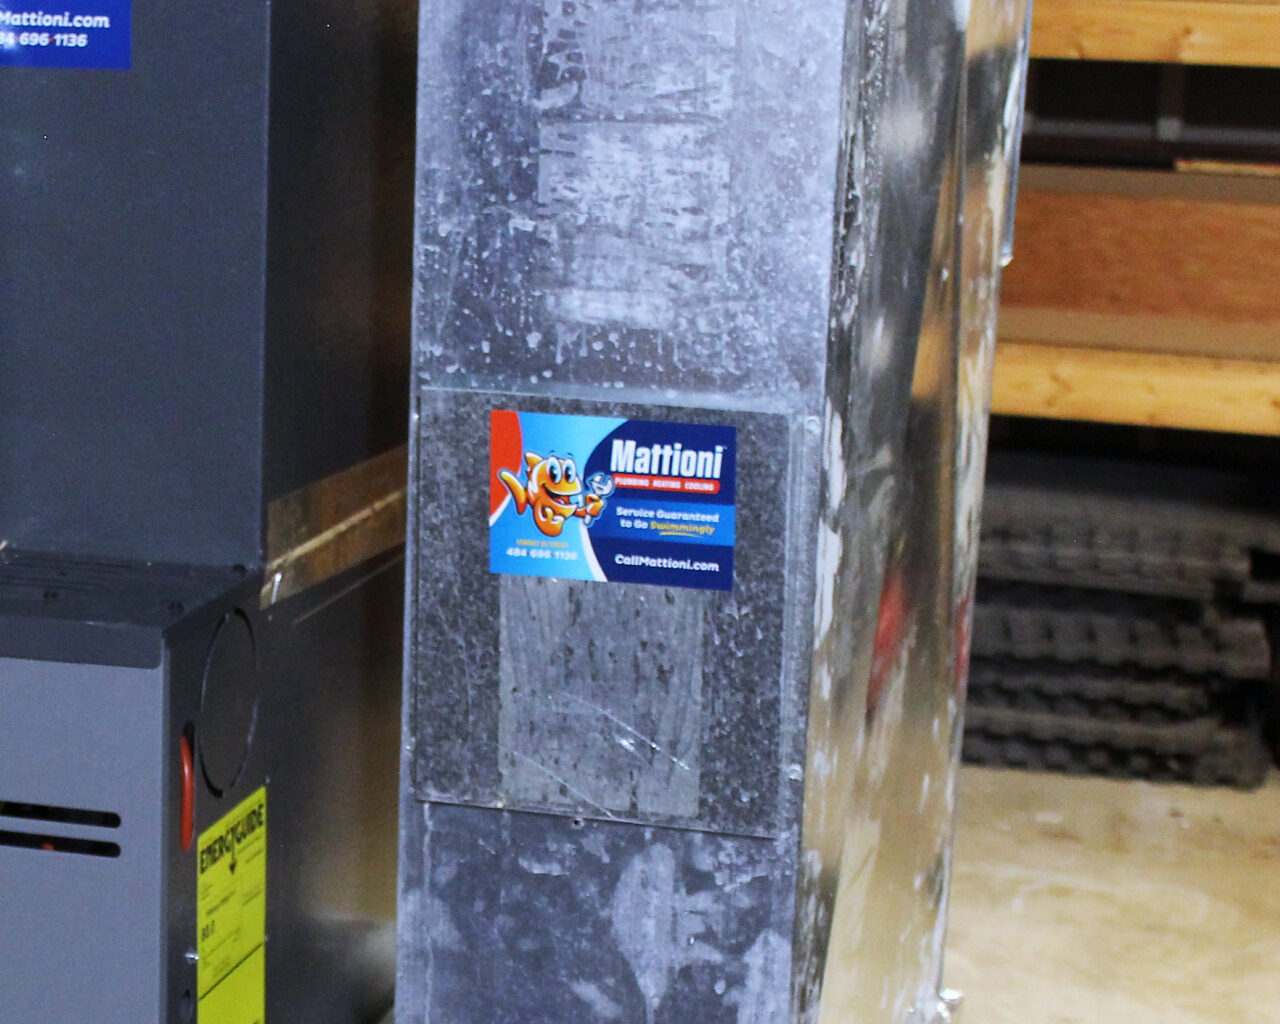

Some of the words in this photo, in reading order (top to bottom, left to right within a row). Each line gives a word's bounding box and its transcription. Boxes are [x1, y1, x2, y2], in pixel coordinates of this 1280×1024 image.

[610, 439, 723, 479] Mattioni
[616, 506, 655, 518] Service
[656, 509, 720, 522] Guaranteed
[620, 518, 632, 528] to
[633, 519, 648, 529] Go
[650, 520, 715, 535] Swimmingly
[614, 553, 720, 572] CallMattioni.com
